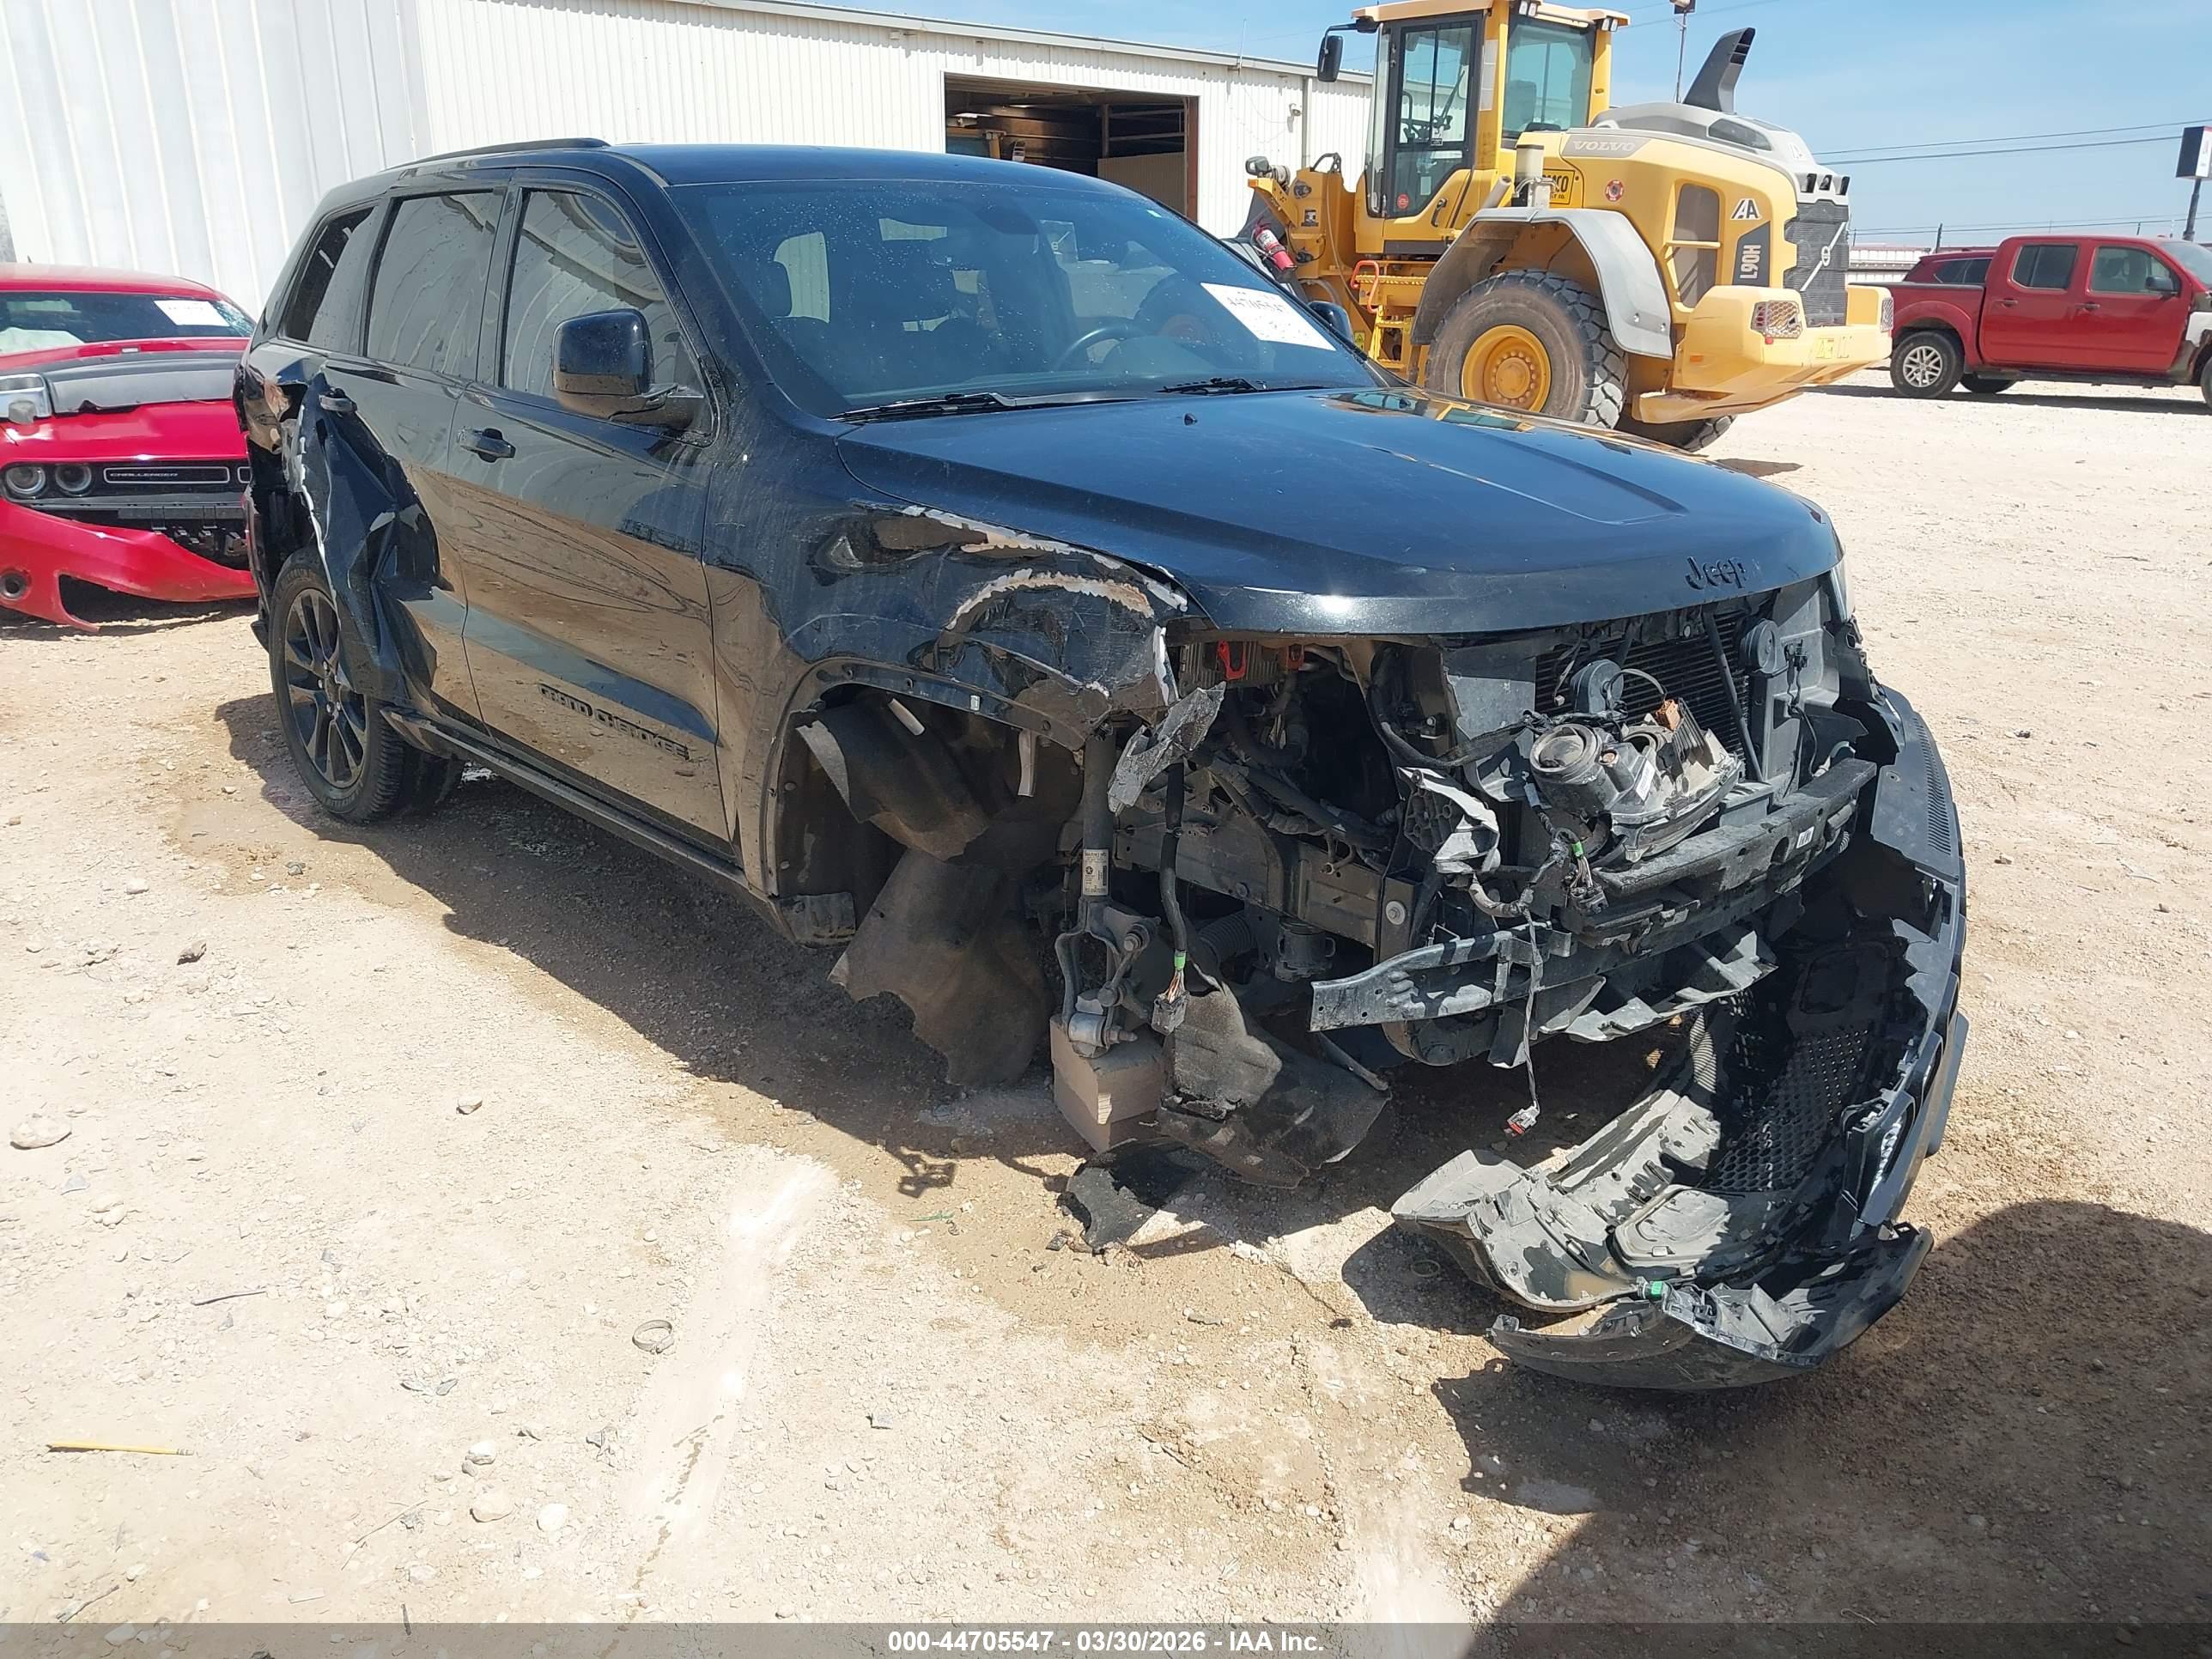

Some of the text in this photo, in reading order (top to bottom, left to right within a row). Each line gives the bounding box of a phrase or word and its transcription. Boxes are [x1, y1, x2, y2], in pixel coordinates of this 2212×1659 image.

[1572, 140, 1636, 152] VOLVO
[1740, 245, 1761, 279] L90H
[1685, 556, 1747, 590] Jeep
[538, 684, 690, 761] GRAND CHEROKEE
